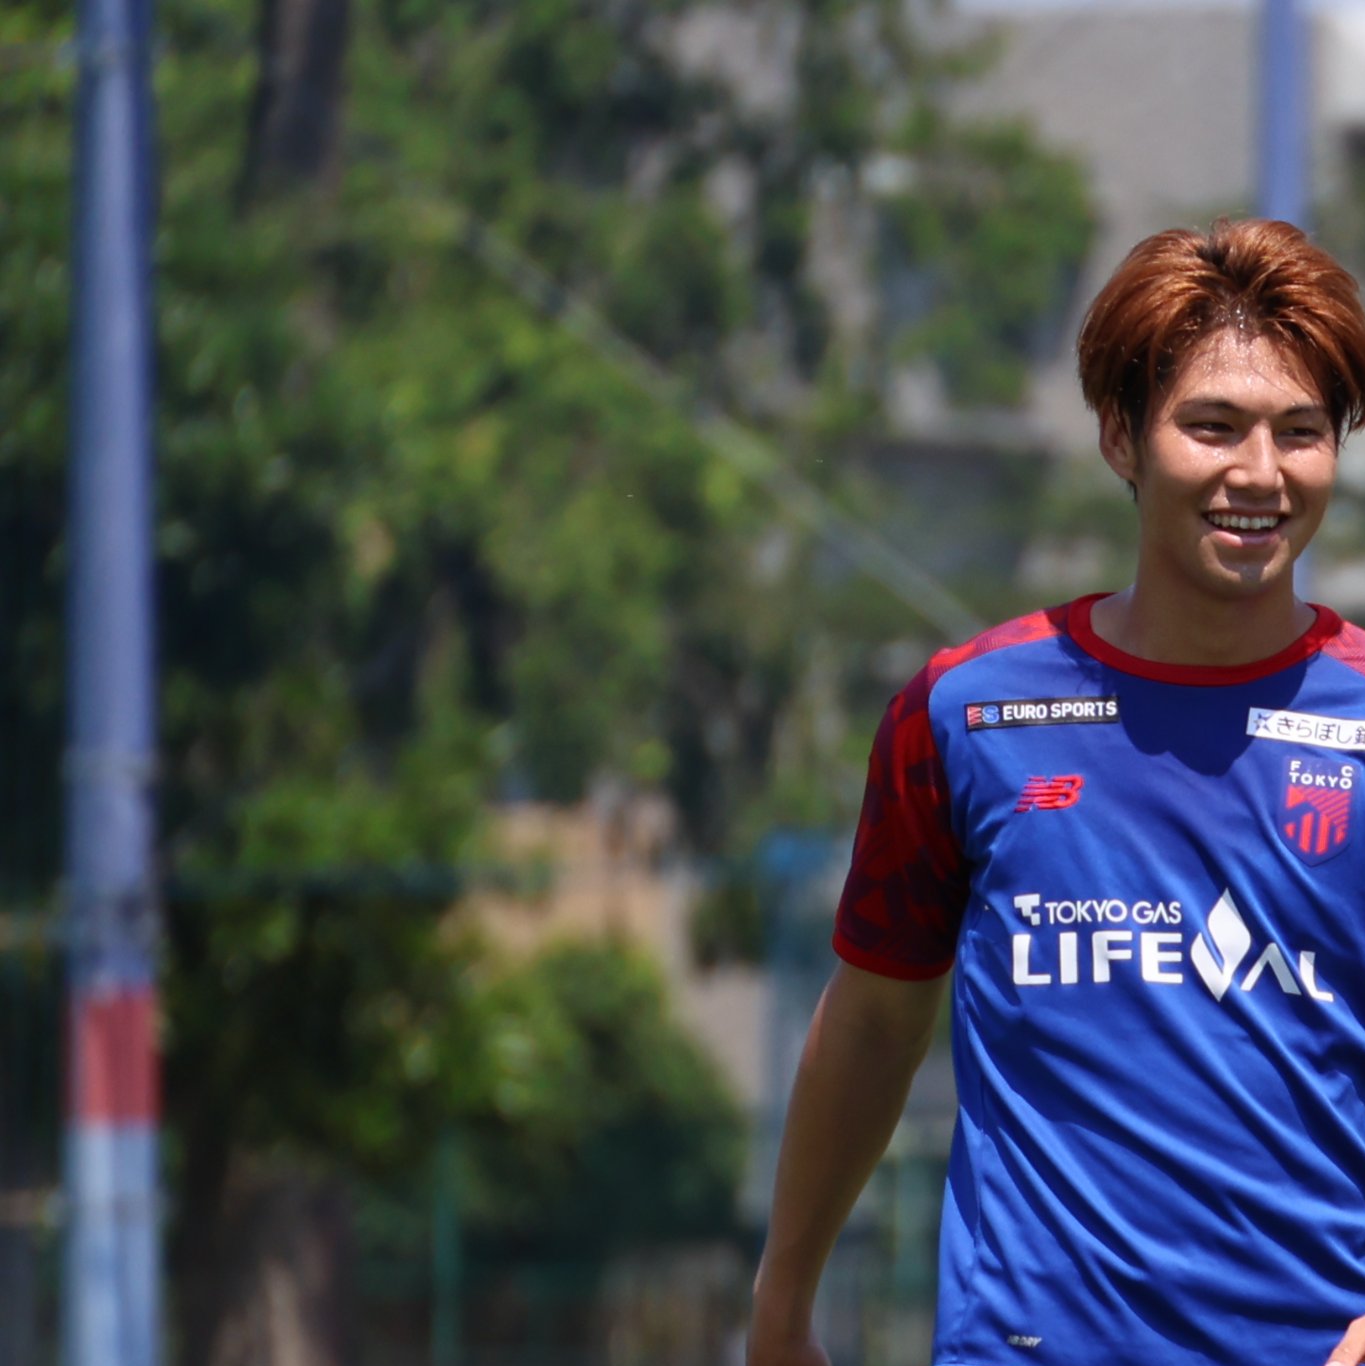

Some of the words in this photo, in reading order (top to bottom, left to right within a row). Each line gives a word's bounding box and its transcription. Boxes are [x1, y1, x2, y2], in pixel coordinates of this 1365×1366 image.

[1002, 704, 1048, 721] EURO
[1050, 701, 1117, 719] SPORTS
[1289, 772, 1353, 790] TOKYO
[1045, 899, 1127, 924] TOKYO
[1132, 901, 1182, 924] GAS
